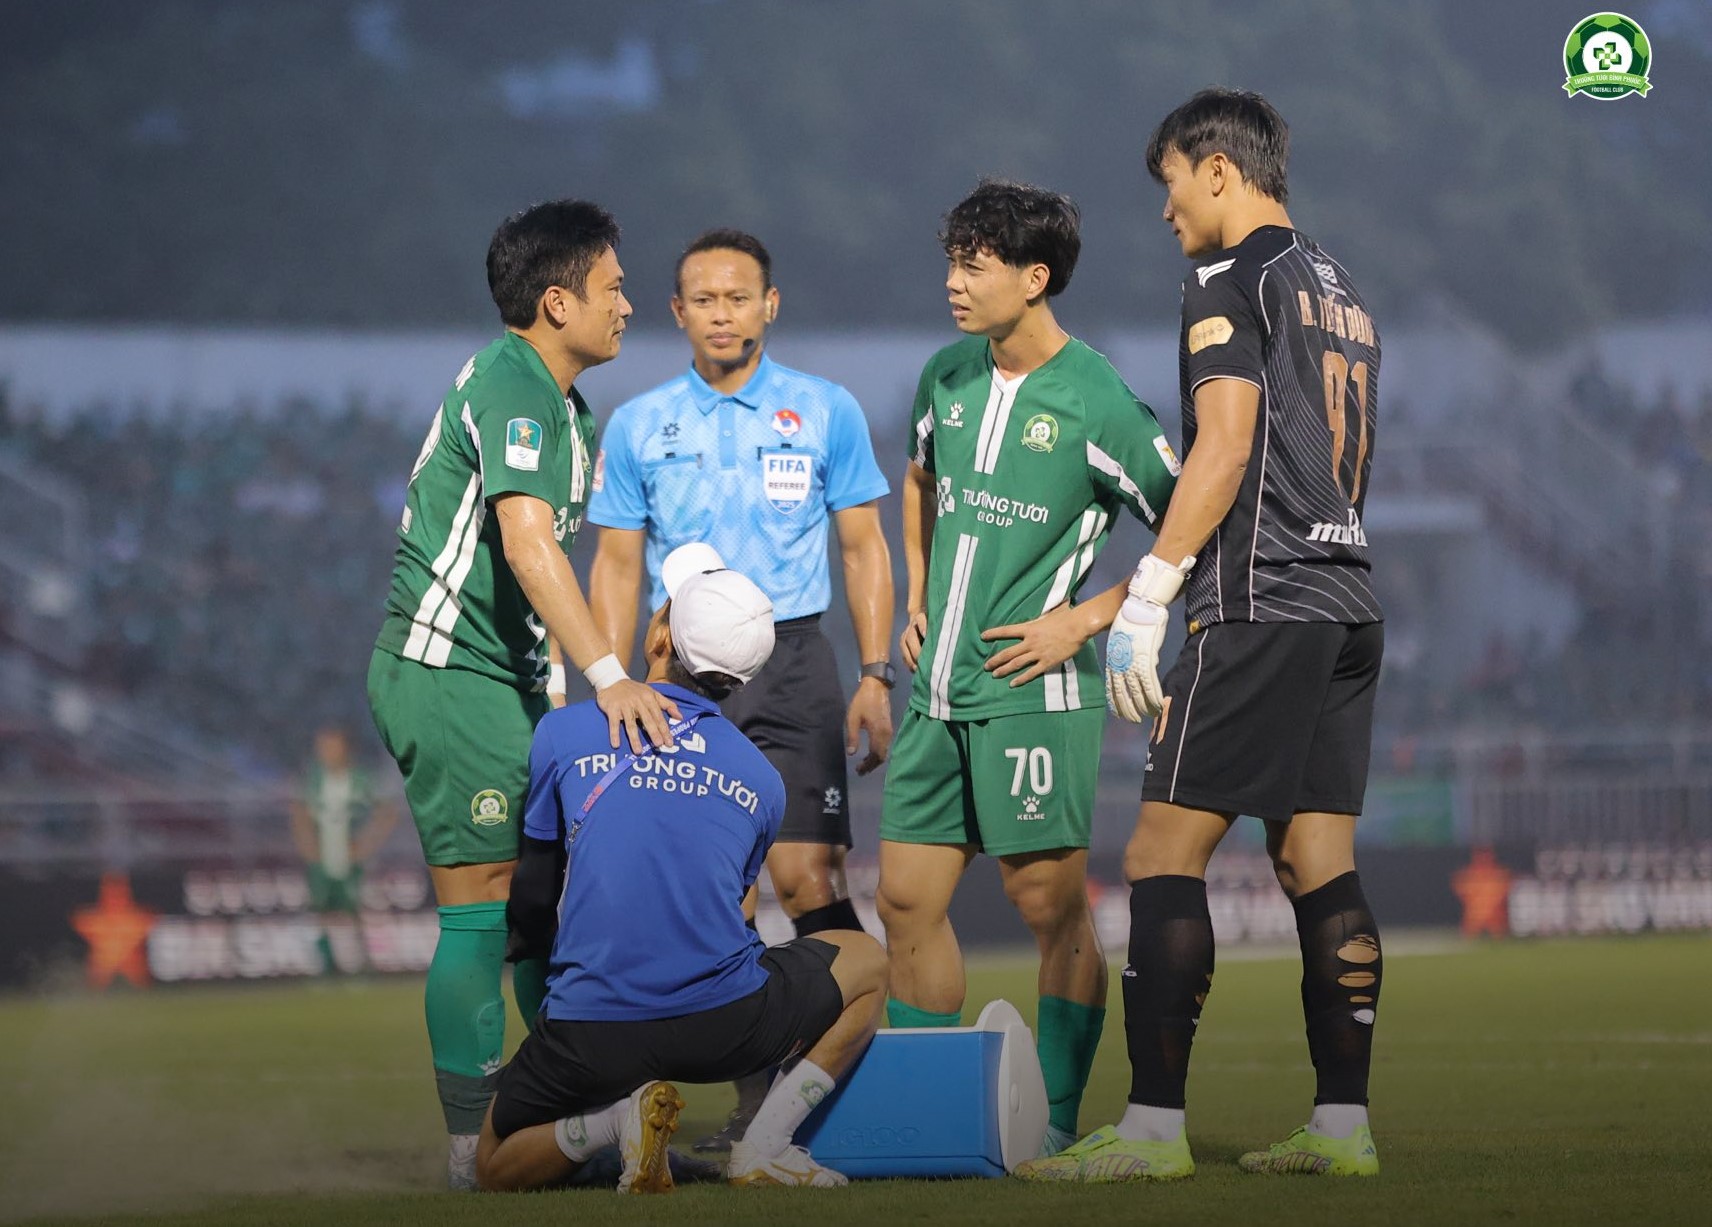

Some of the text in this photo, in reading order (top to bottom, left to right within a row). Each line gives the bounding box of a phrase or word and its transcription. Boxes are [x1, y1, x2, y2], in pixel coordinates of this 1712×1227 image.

[769, 459, 806, 473] FIFA
[768, 482, 806, 490] REFEREE
[1011, 500, 1049, 524] TƯƠI
[1005, 746, 1053, 796] 70
[629, 775, 709, 797] GROUP
[702, 766, 759, 815] TƯƠI
[1016, 813, 1045, 821] KELME
